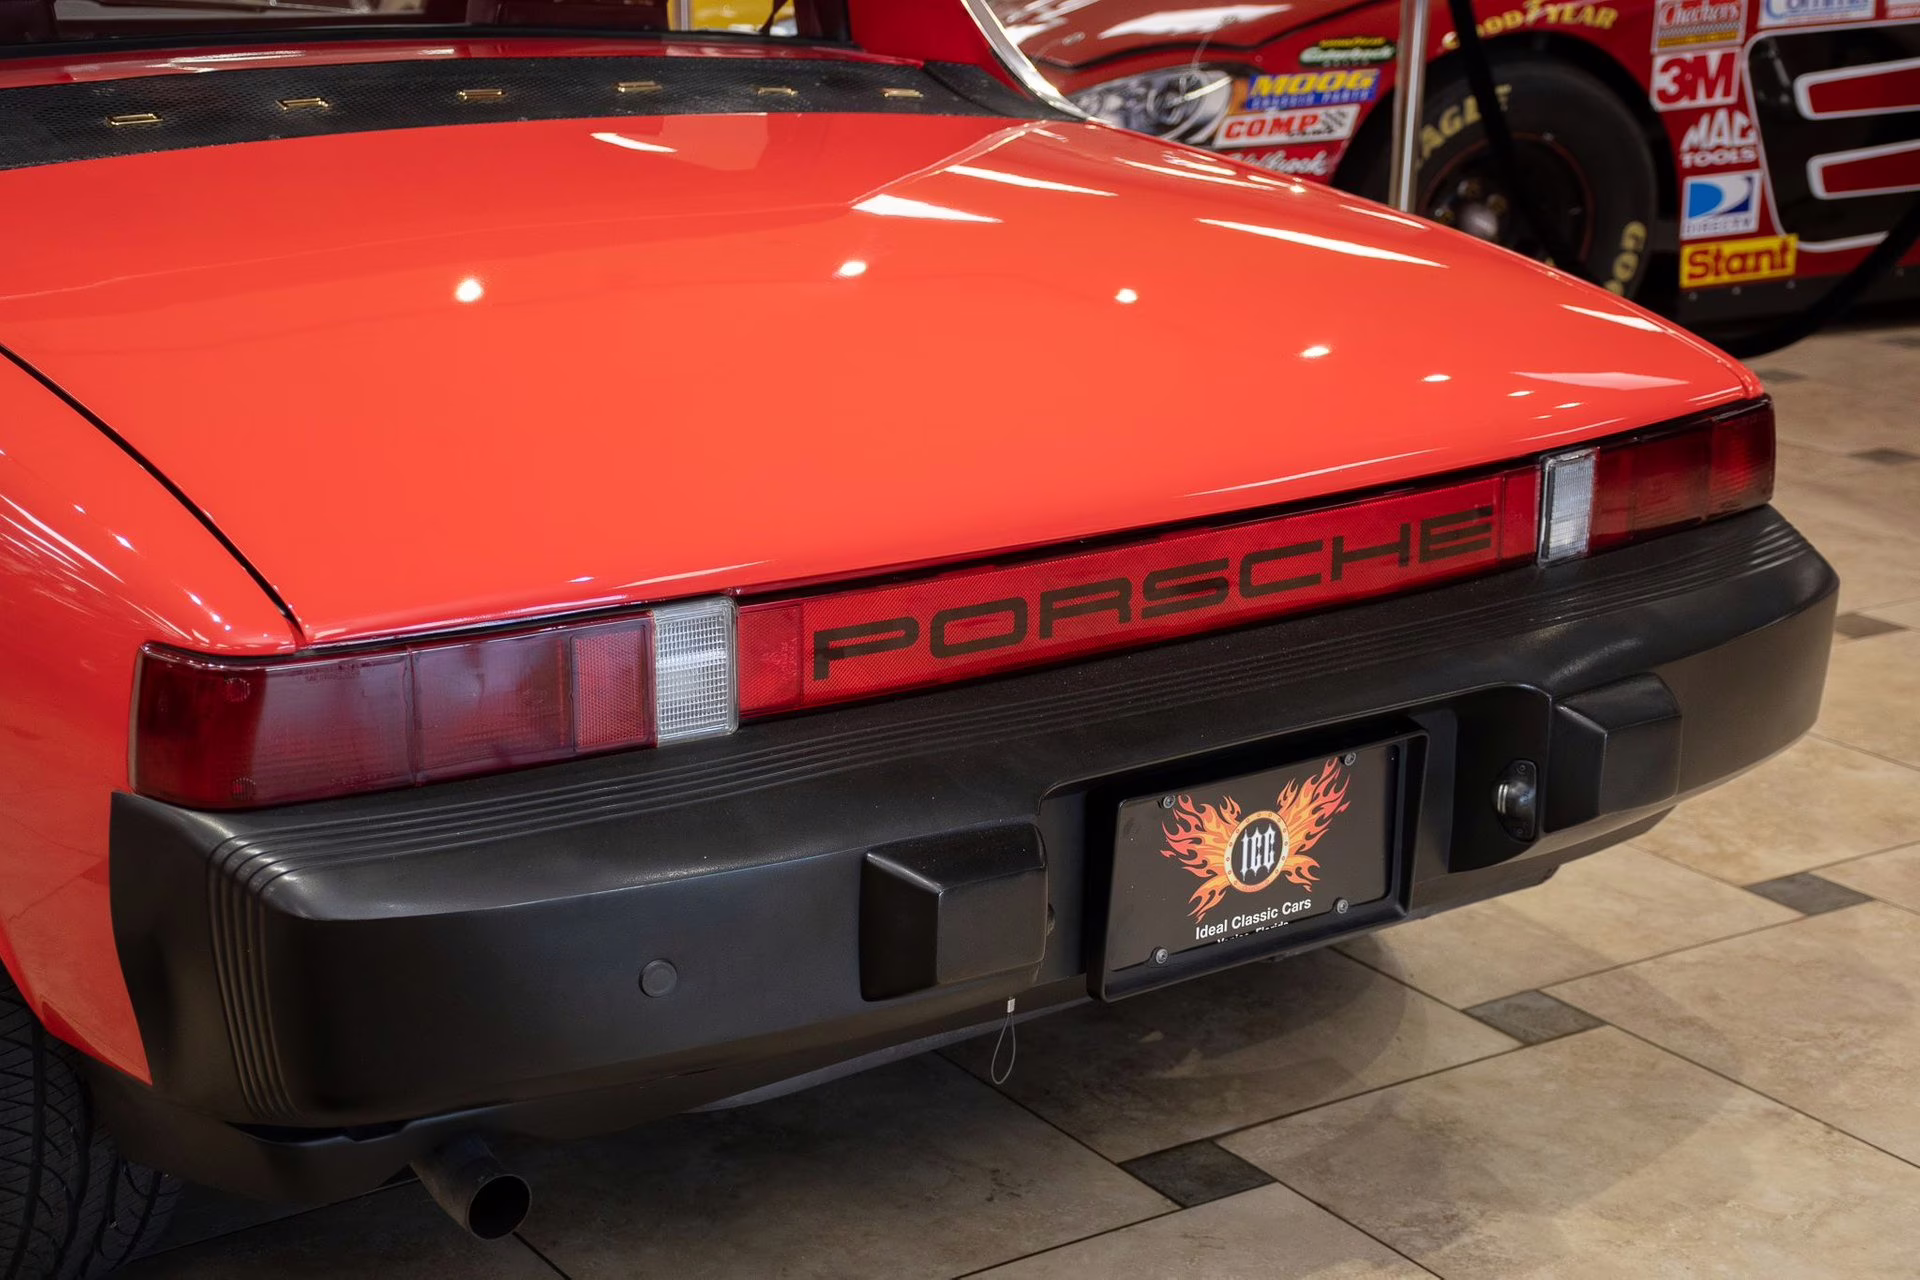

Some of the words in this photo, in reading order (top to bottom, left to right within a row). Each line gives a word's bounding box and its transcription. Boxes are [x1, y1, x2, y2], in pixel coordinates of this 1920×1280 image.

[1250, 69, 1377, 97] MOOG
[1656, 52, 1737, 104] 3M
[1225, 113, 1320, 141] COMP
[1680, 108, 1758, 152] MAC
[1680, 147, 1759, 169] TOOLS
[1688, 240, 1790, 280] Stant
[813, 505, 1493, 681] PORSCHE
[1195, 919, 1228, 940] Ideal
[1231, 907, 1279, 930] Classic
[1281, 898, 1312, 915] Cars
